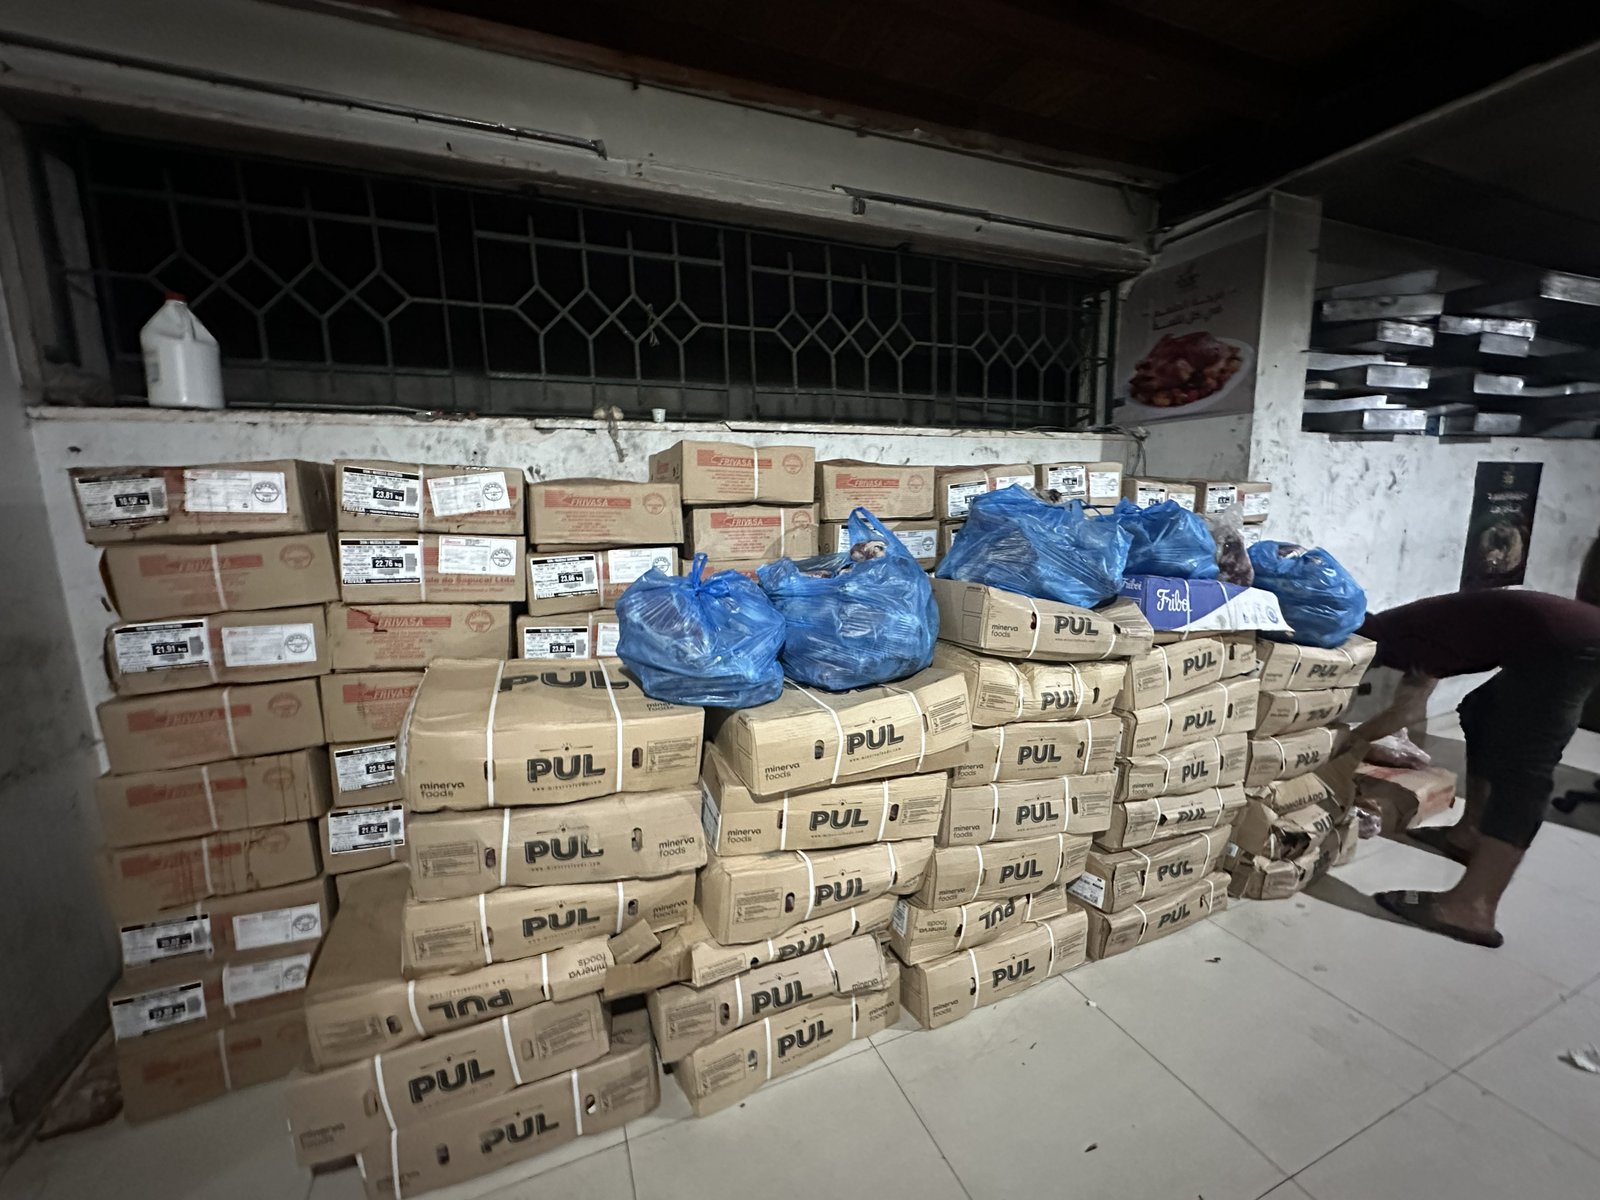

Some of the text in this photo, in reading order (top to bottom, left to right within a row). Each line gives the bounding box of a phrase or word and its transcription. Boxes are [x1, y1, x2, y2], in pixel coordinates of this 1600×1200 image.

[719, 458, 753, 467] FRIVASA
[854, 479, 883, 487] FRIVASA
[570, 497, 609, 507] FRIVASA
[730, 518, 764, 527] FRIVASA
[1054, 615, 1099, 637] PUL
[1183, 651, 1217, 676] PUL
[1307, 664, 1339, 678] PUL
[498, 669, 629, 693] PUL
[1182, 710, 1216, 732] PUL
[846, 723, 904, 755] PUL
[1017, 745, 1061, 765] PUL
[1295, 750, 1320, 768] PUL
[527, 754, 605, 783] PUL
[764, 762, 800, 773] minerva
[765, 770, 791, 782] foods
[1182, 760, 1208, 783] PUL
[420, 782, 464, 791] minerva
[421, 789, 454, 799] foods
[809, 808, 869, 831] PUL
[1016, 802, 1059, 825] PUL
[659, 836, 695, 849] minerva
[727, 828, 762, 837] minerva
[727, 835, 752, 844] foods
[525, 835, 604, 864] PUL
[659, 846, 686, 858] foods
[1000, 859, 1043, 883] PUL
[1157, 860, 1193, 881] PUL
[813, 877, 870, 907] PUL
[522, 907, 600, 938] PUL
[979, 898, 1016, 930] PUL
[1157, 904, 1190, 928] PUL
[778, 933, 832, 960] PUL
[568, 962, 608, 979] minerva
[992, 958, 1035, 988] PUL
[428, 989, 515, 1021] PUL
[751, 980, 813, 1015] PUL
[777, 1019, 833, 1058] PUL
[408, 1058, 496, 1105] PUL
[480, 1112, 560, 1155] PUL
